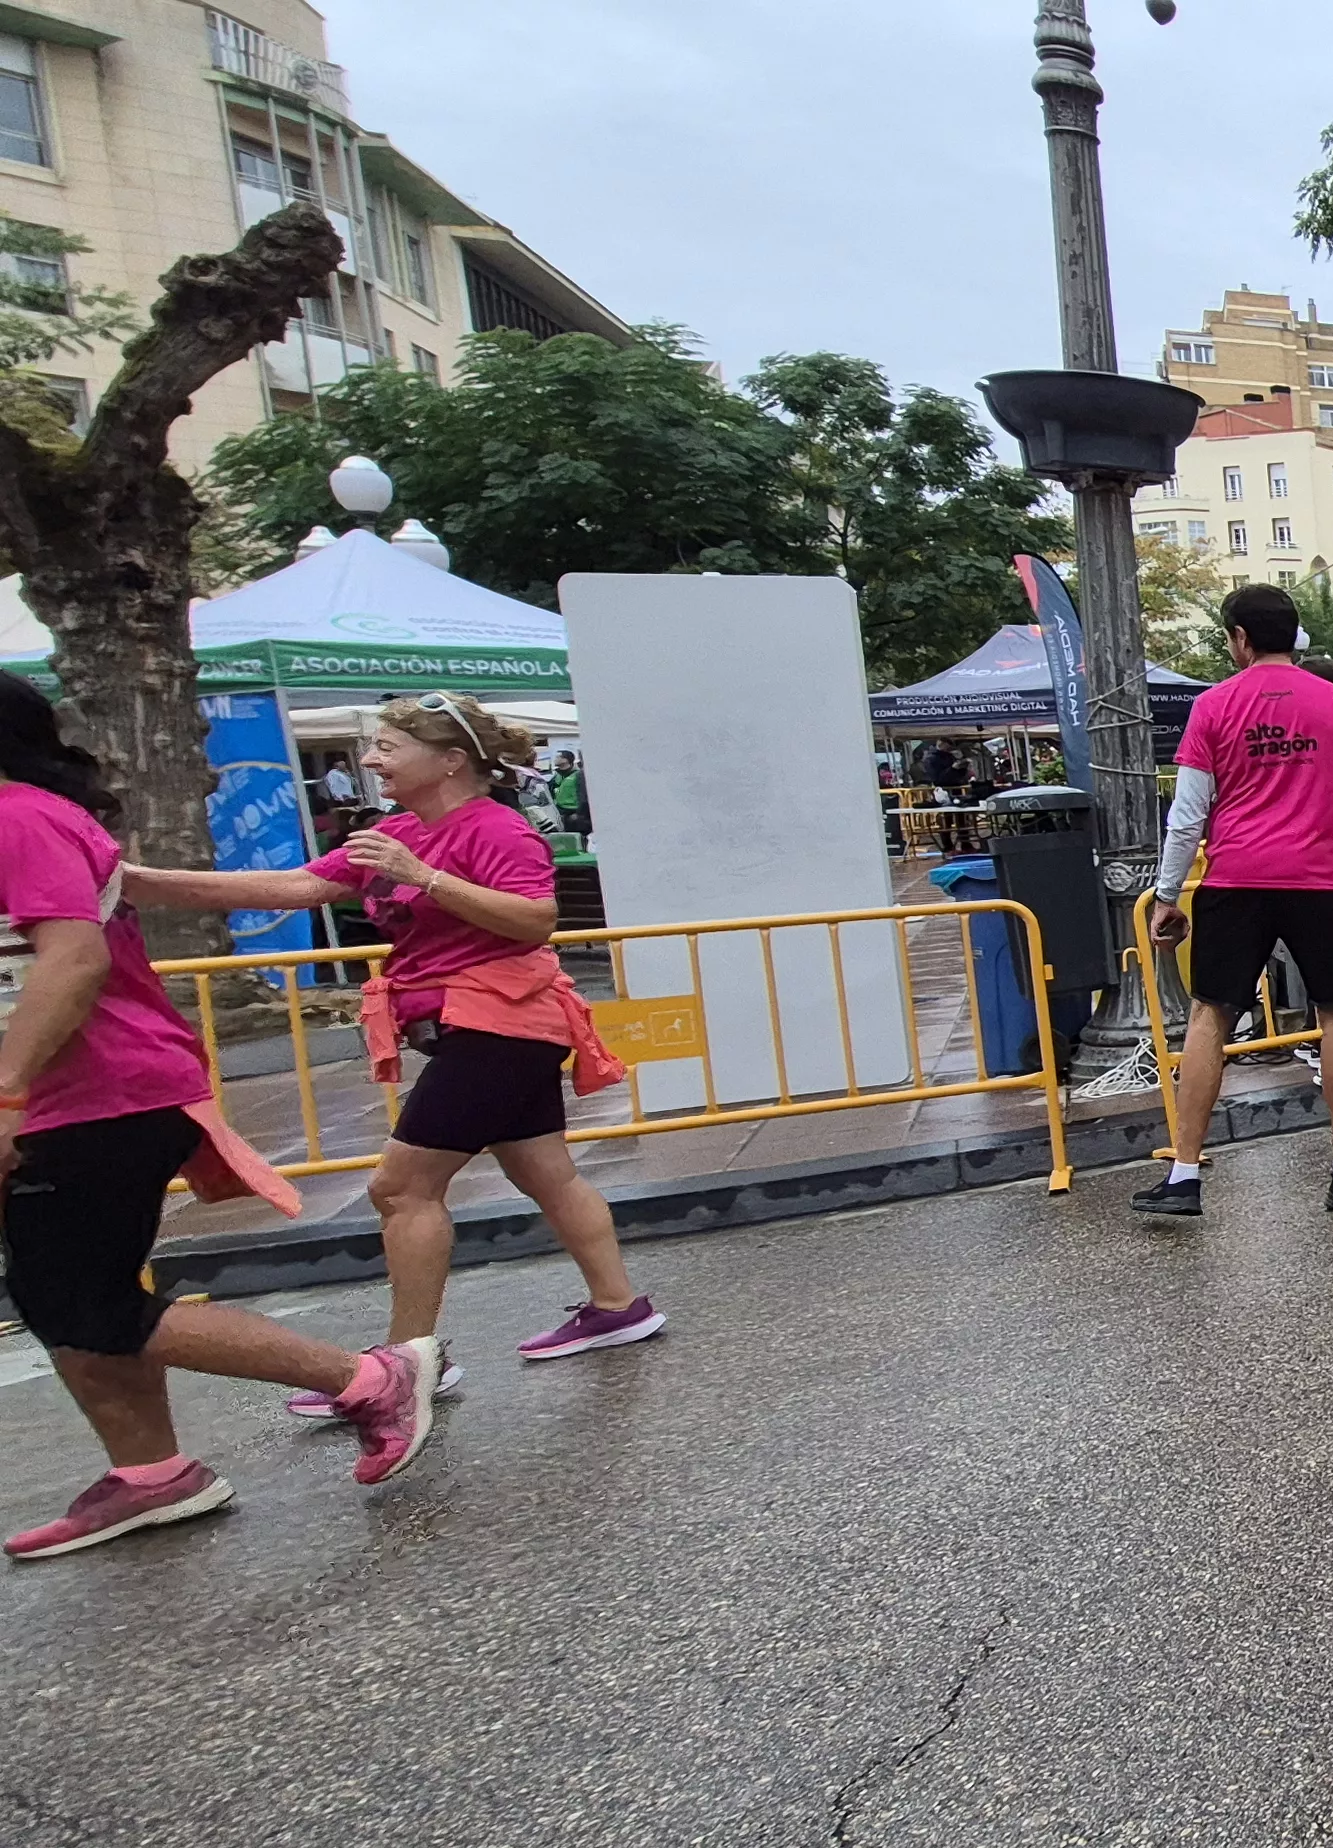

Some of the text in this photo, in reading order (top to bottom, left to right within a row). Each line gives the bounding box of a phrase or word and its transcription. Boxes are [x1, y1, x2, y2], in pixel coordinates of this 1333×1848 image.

[291, 655, 443, 676] ASOCIACIÓN
[447, 655, 565, 676] ESPAÑOLA
[895, 691, 1022, 706] PRODUCCIÓN AUDIOVISUAL
[873, 705, 945, 718] COMUNICACIÓN
[954, 703, 1009, 714] MARKETING
[1010, 701, 1048, 711] DIGITAL
[1244, 722, 1286, 742] alto
